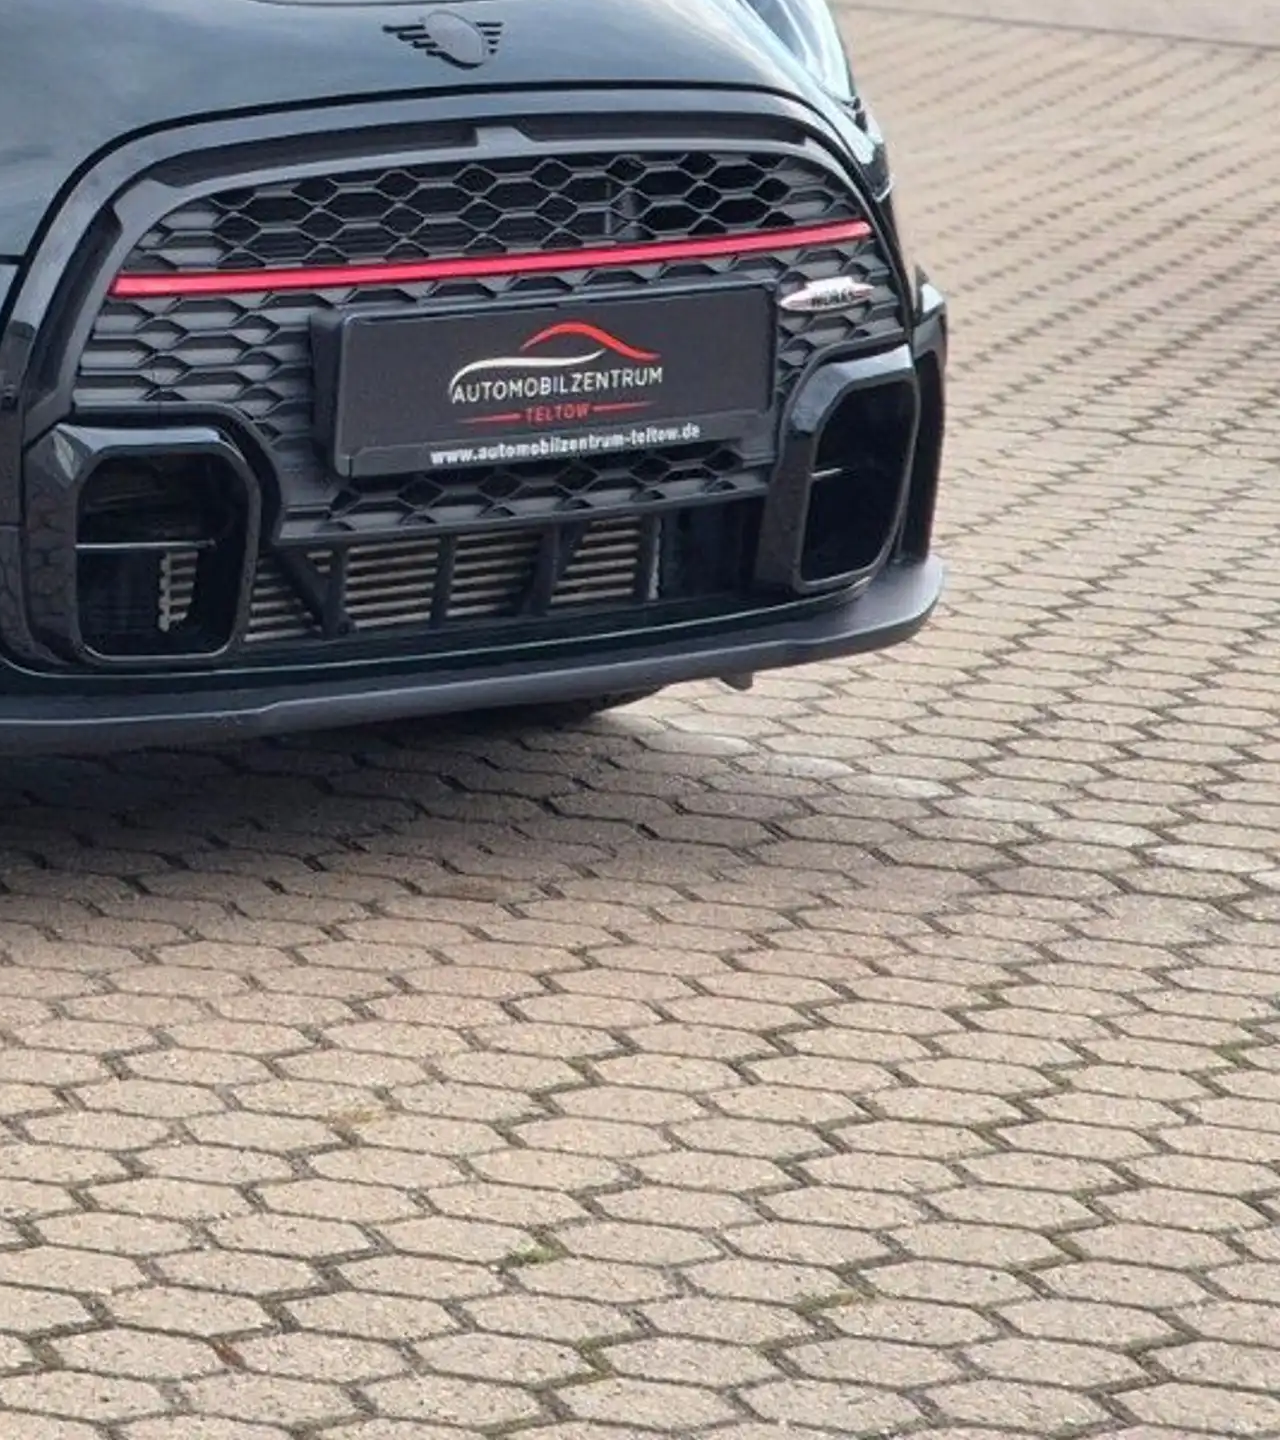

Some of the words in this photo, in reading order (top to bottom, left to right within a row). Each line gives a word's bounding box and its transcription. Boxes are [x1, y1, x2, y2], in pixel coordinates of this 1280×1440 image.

[452, 366, 663, 404] AUTOMOBILZENTRUM
[526, 403, 590, 423] TELTOW
[430, 422, 700, 464] www.automobilzentrum-teltow.de
